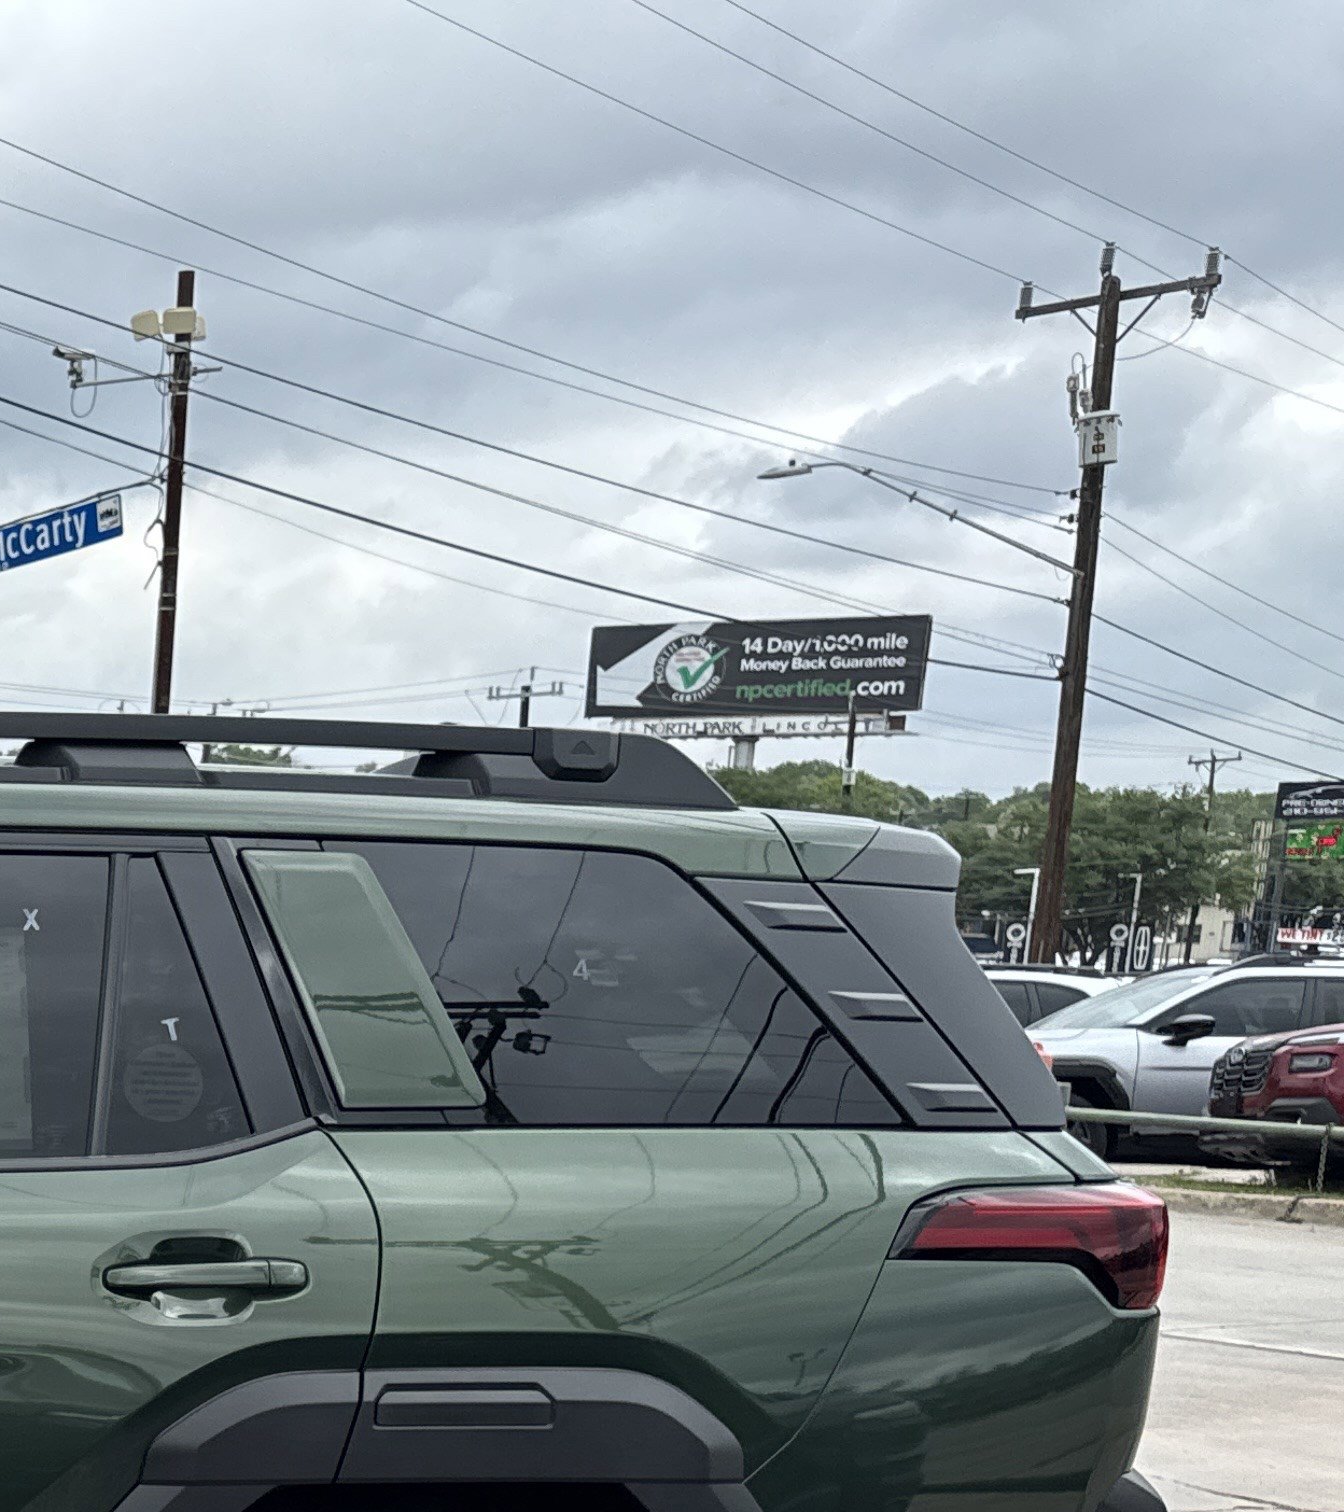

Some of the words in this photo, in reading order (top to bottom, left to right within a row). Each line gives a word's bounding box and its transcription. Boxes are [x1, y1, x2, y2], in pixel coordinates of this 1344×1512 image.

[741, 637, 763, 654] 14
[866, 632, 909, 650] mile
[740, 657, 790, 673] Money
[791, 656, 828, 670] Back
[829, 654, 907, 670] Guarantee
[643, 722, 696, 735] NORTH
[703, 719, 744, 734] PARK
[23, 908, 40, 931] X
[572, 958, 591, 981] 4
[160, 1017, 180, 1041] T
